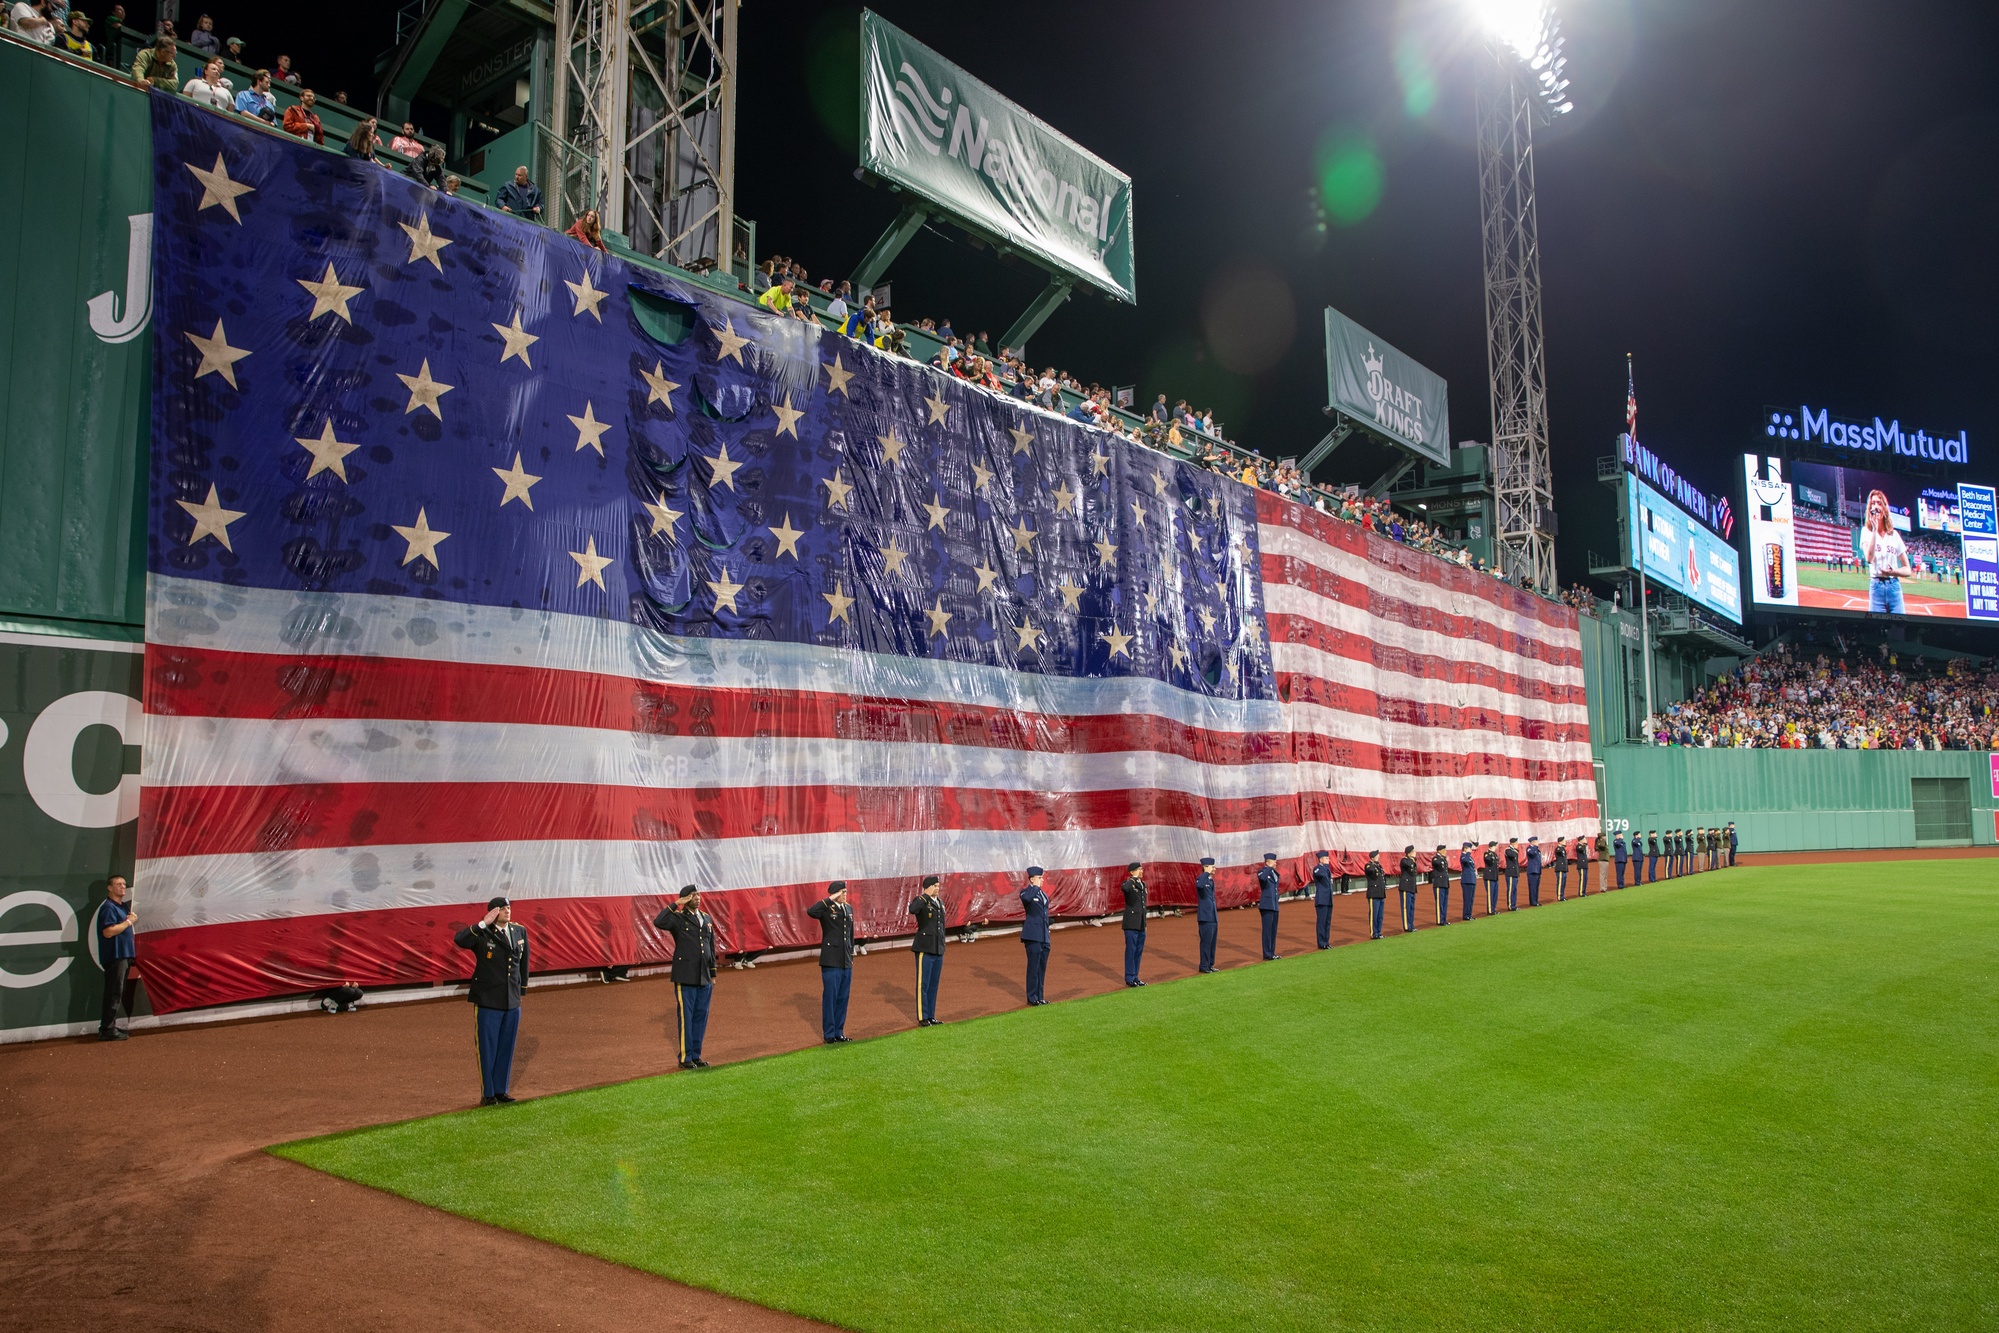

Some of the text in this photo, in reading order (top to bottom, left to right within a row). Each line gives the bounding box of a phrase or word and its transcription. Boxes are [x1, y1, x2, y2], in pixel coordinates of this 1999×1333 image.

[461, 36, 532, 90] MONSTER
[1367, 371, 1422, 420] DRAFT
[1374, 400, 1423, 445] KINGS
[1801, 405, 1968, 463] MassMutual
[1625, 433, 1719, 530] BANK OF AMERIA
[1750, 480, 1787, 490] NISSAN
[1961, 490, 1991, 502] Beth Israel
[1430, 496, 1481, 510] MONSTER
[1962, 500, 1993, 511] Deaconess
[1963, 509, 1986, 520] Medical
[1964, 518, 1983, 529] Center
[1967, 570, 1979, 582] ANY
[1970, 584, 1981, 596] ANY
[1972, 598, 1984, 610] ANY
[1607, 818, 1630, 832] 379
